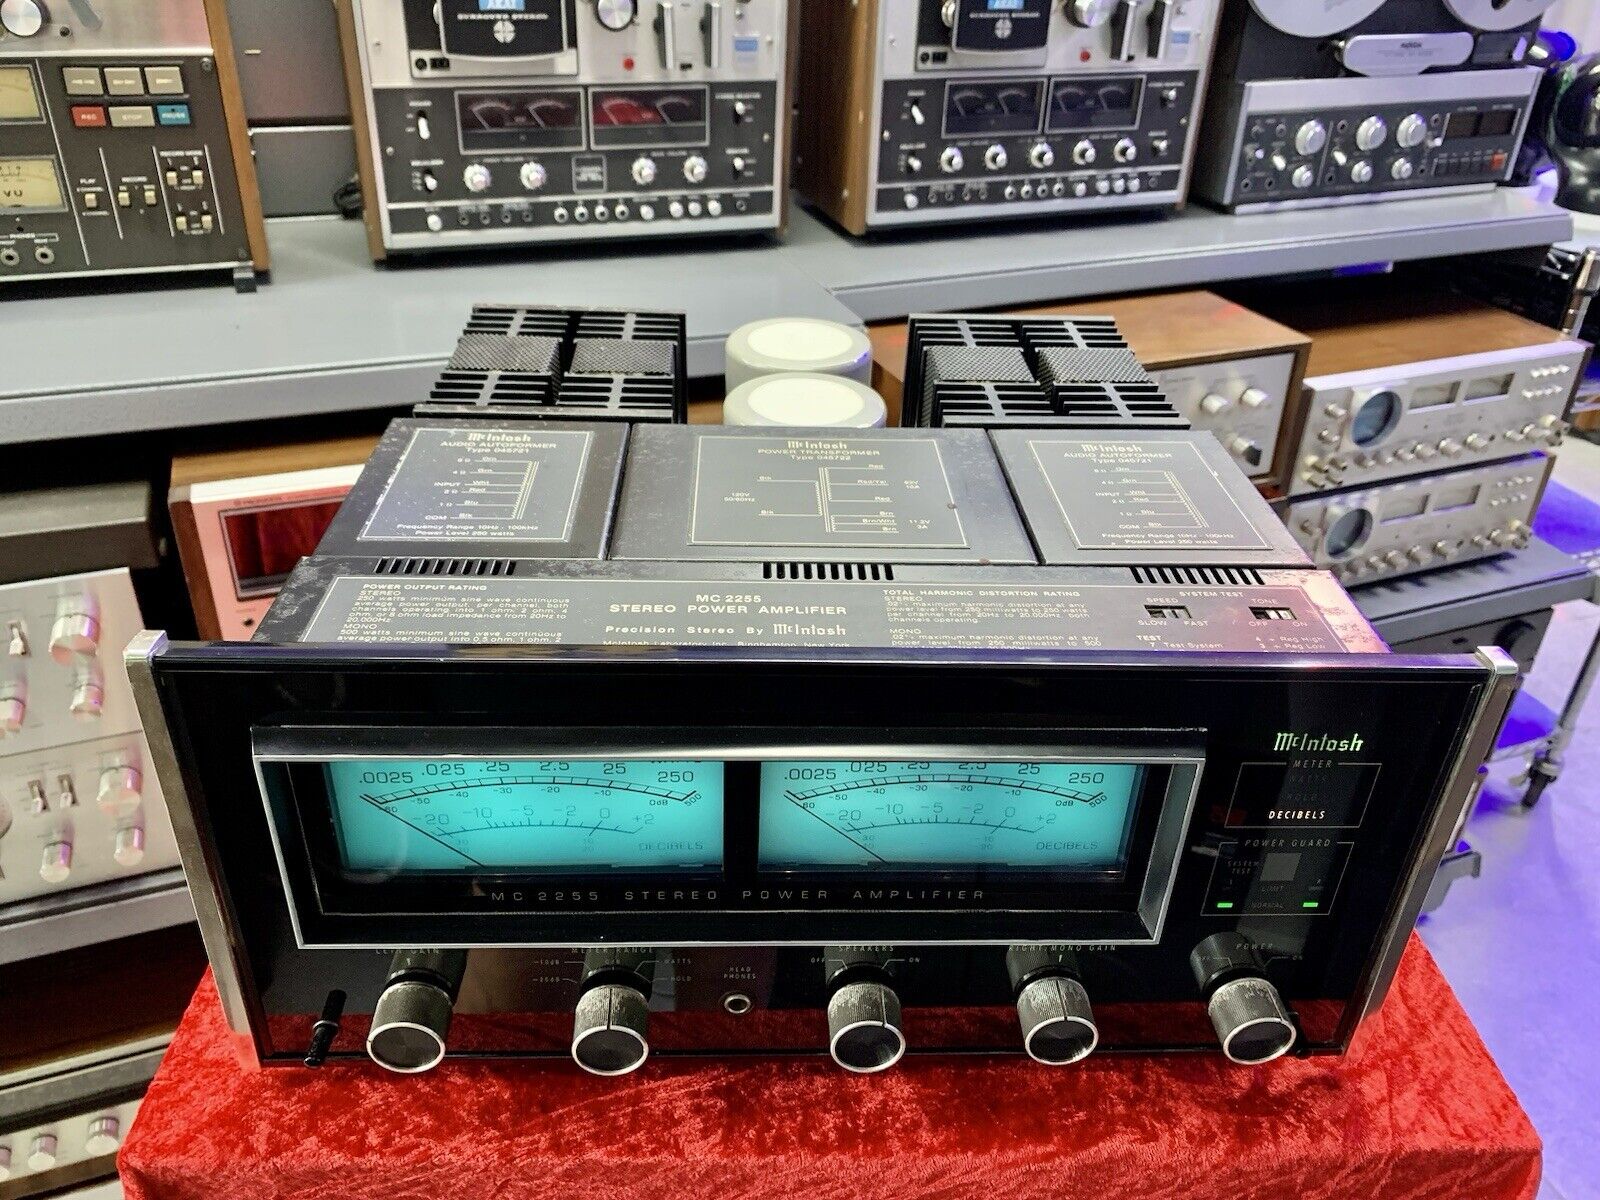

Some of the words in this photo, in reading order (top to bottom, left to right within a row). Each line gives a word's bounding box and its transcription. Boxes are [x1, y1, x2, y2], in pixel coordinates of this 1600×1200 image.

[468, 432, 532, 442] McIntosh
[787, 440, 848, 450] McIntosh
[1081, 444, 1142, 452] McIntosh
[696, 594, 721, 602] MC
[725, 595, 762, 603] 2255
[609, 604, 676, 613] STEREO
[687, 605, 748, 614] POWER
[758, 605, 847, 615] AMPLIFIER
[686, 626, 734, 634] Stereo
[746, 627, 764, 635] By
[773, 623, 846, 635] McIntosh
[1273, 732, 1363, 751] McIntosh
[479, 762, 510, 772] .25
[540, 762, 570, 771] 2.5
[603, 763, 626, 775] 25
[845, 762, 887, 772] .025
[1018, 763, 1040, 775] 25
[1293, 759, 1333, 768] METER
[421, 763, 466, 776] .025
[784, 768, 836, 780] .0025
[359, 771, 413, 784] .0025
[657, 771, 694, 783] 250
[1068, 772, 1104, 784] 250
[684, 794, 702, 806] 500
[1089, 794, 1108, 808] 500
[463, 807, 493, 818] -10
[511, 805, 534, 815] -5
[554, 806, 576, 816] -2
[600, 808, 610, 819] 0
[876, 804, 904, 815] -10
[921, 803, 943, 813] -5
[964, 804, 984, 814] -2
[1005, 807, 1016, 818] 0
[413, 814, 450, 825] -20
[633, 814, 654, 825] +2
[826, 810, 861, 820] -20
[1037, 813, 1056, 824] +2
[1268, 811, 1326, 820] DECIBELS
[1036, 841, 1098, 850] DECIBELS
[1244, 839, 1285, 847] POWER
[1291, 839, 1331, 847] GUARD
[492, 892, 523, 900] MC
[538, 892, 598, 900] 2255
[624, 890, 717, 900] STEREO
[742, 890, 828, 900] POWER
[853, 890, 983, 900] AMPLIFIER
